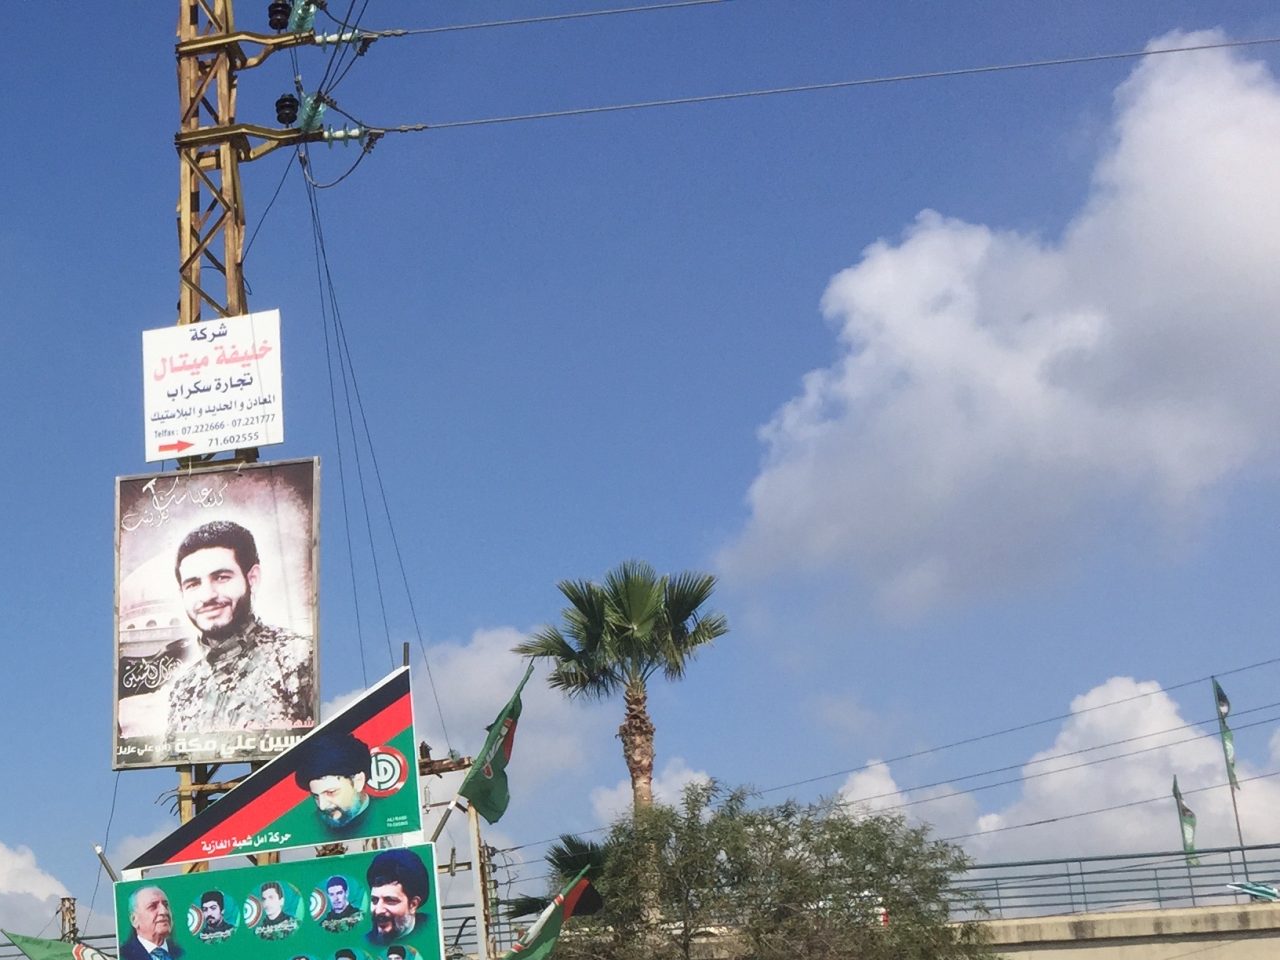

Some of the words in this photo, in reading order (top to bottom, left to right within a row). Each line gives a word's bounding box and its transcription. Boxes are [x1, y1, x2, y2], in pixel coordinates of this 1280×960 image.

[190, 323, 228, 342] شركة
[214, 339, 273, 367] خليفة
[153, 353, 209, 382] ميتال
[167, 380, 212, 402] سكراب
[214, 373, 254, 393] تجارة
[208, 432, 260, 447] 71.602555
[175, 737, 217, 753] مكة
[220, 735, 257, 758] علي
[201, 839, 231, 854] الغازية
[269, 831, 292, 844] حركة
